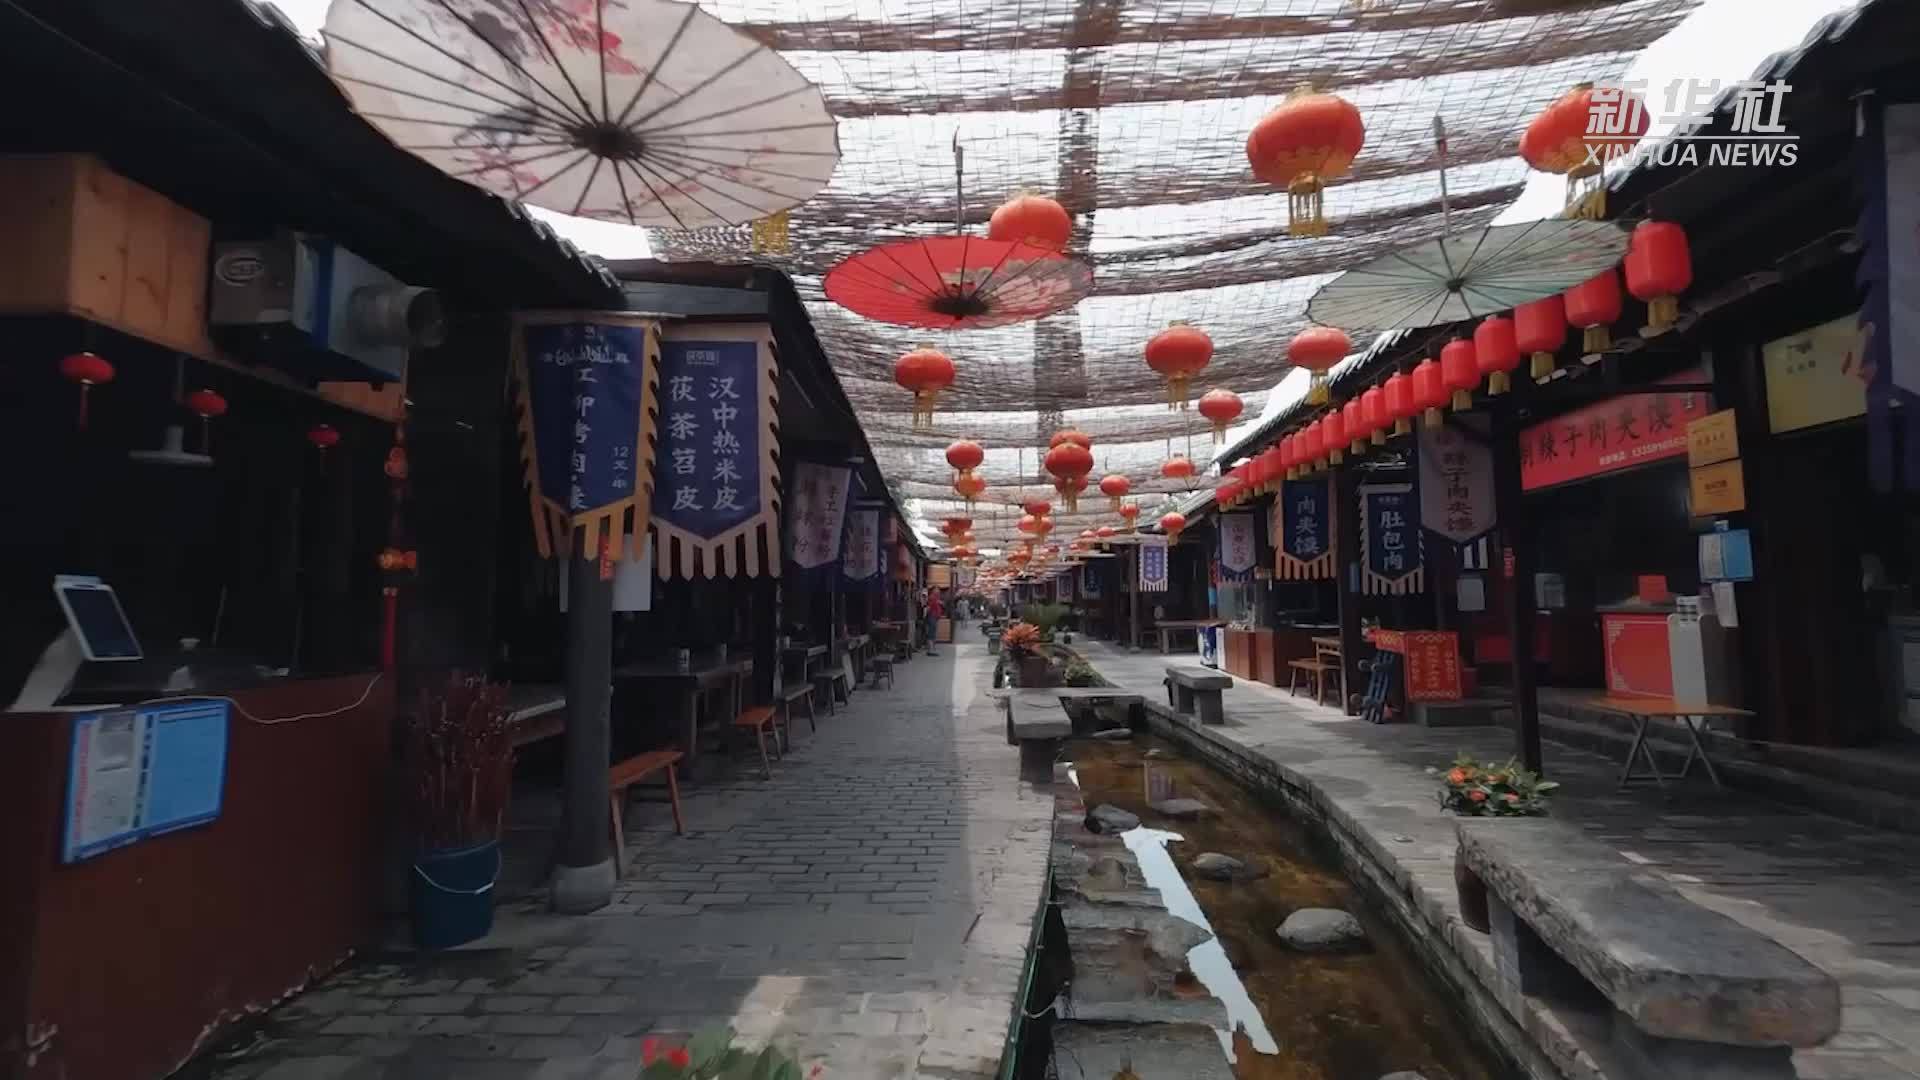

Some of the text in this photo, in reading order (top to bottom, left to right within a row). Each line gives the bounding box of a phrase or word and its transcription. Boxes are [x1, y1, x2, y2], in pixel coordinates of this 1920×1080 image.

[708, 375, 745, 512] 汉中热米皮
[1380, 511, 1406, 572] 肚包肉
